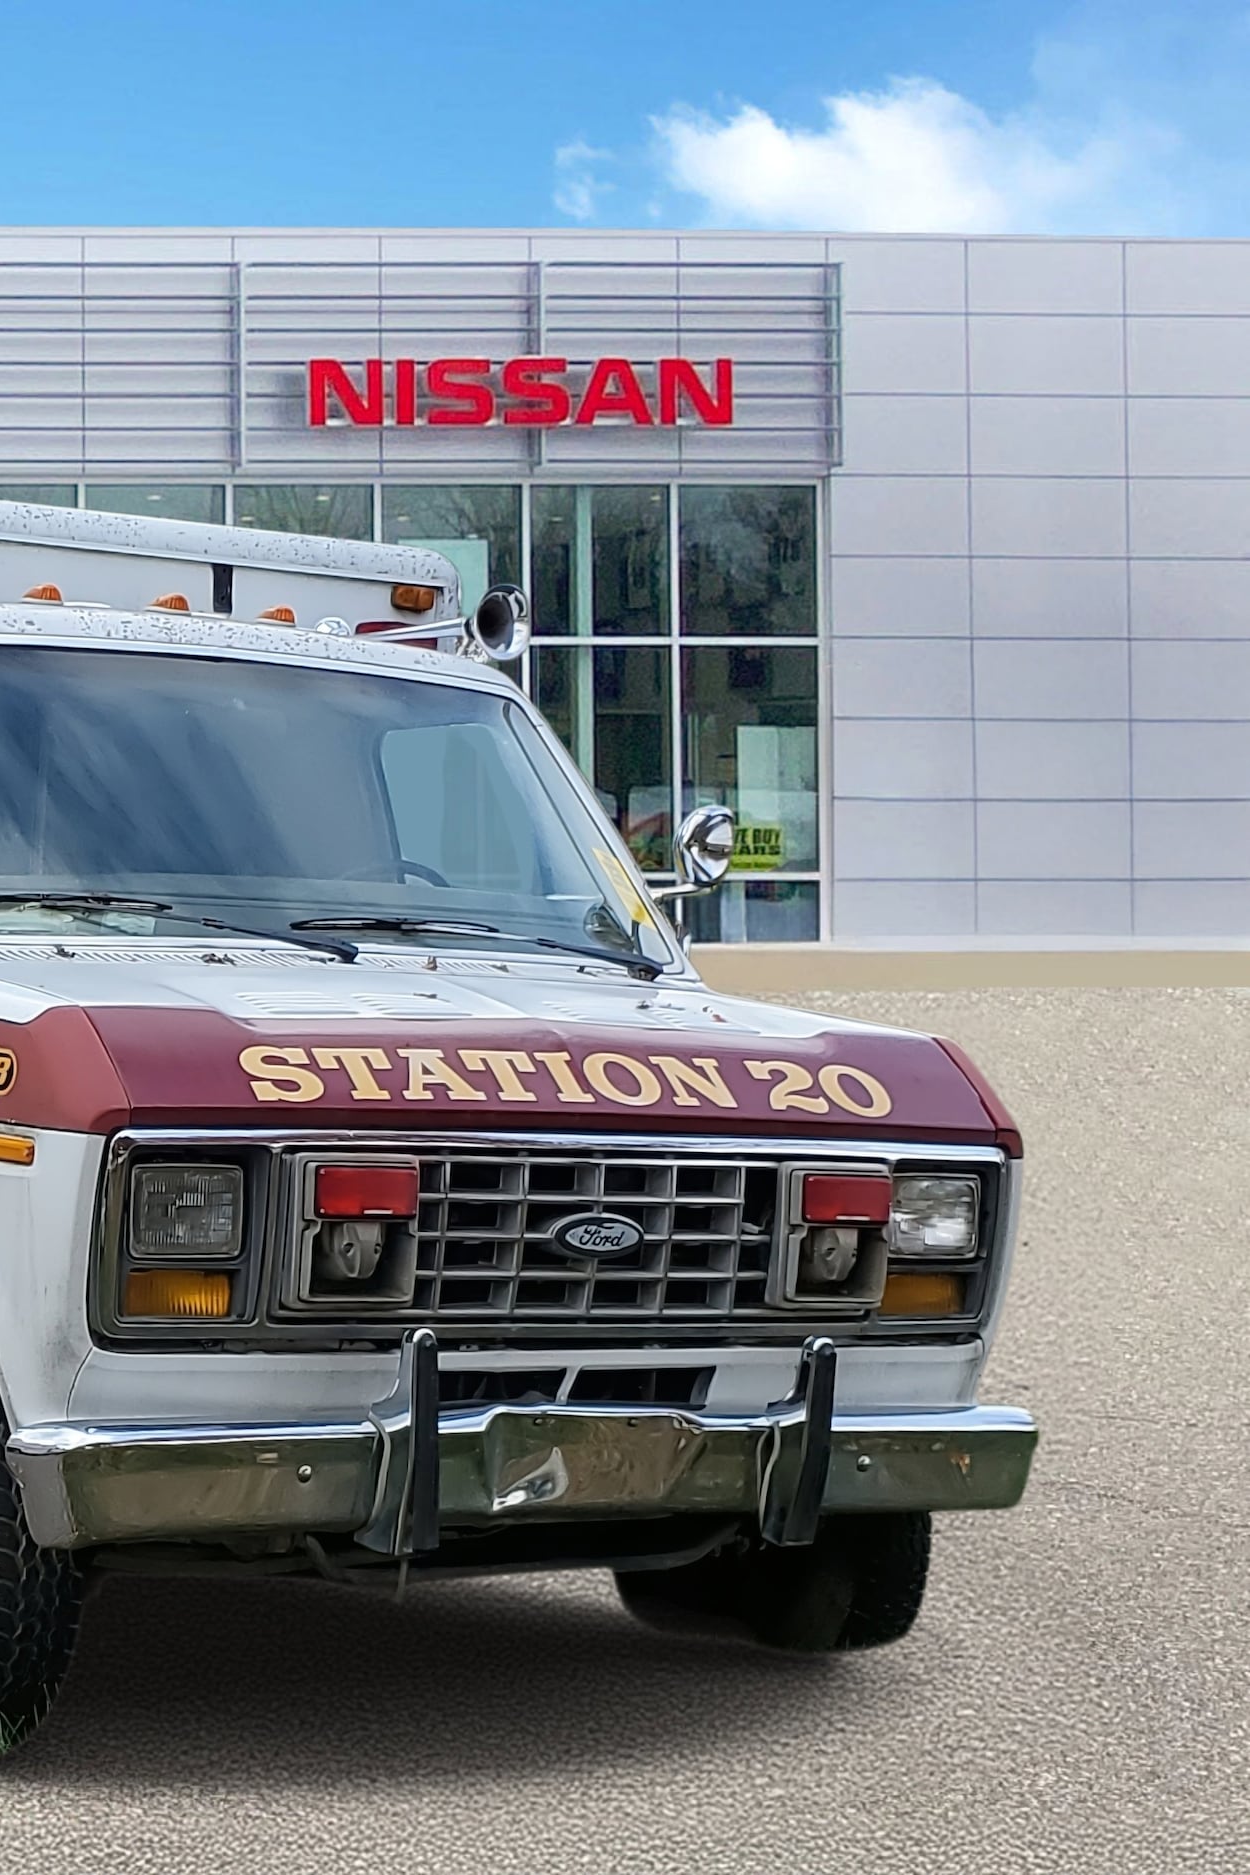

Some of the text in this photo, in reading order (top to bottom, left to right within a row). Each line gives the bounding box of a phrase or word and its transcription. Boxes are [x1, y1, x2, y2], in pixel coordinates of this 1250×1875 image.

[308, 357, 733, 427] NISSAN
[734, 845, 781, 856] ARS
[238, 1044, 893, 1119] STATION 20
[579, 1222, 626, 1247] Ford
